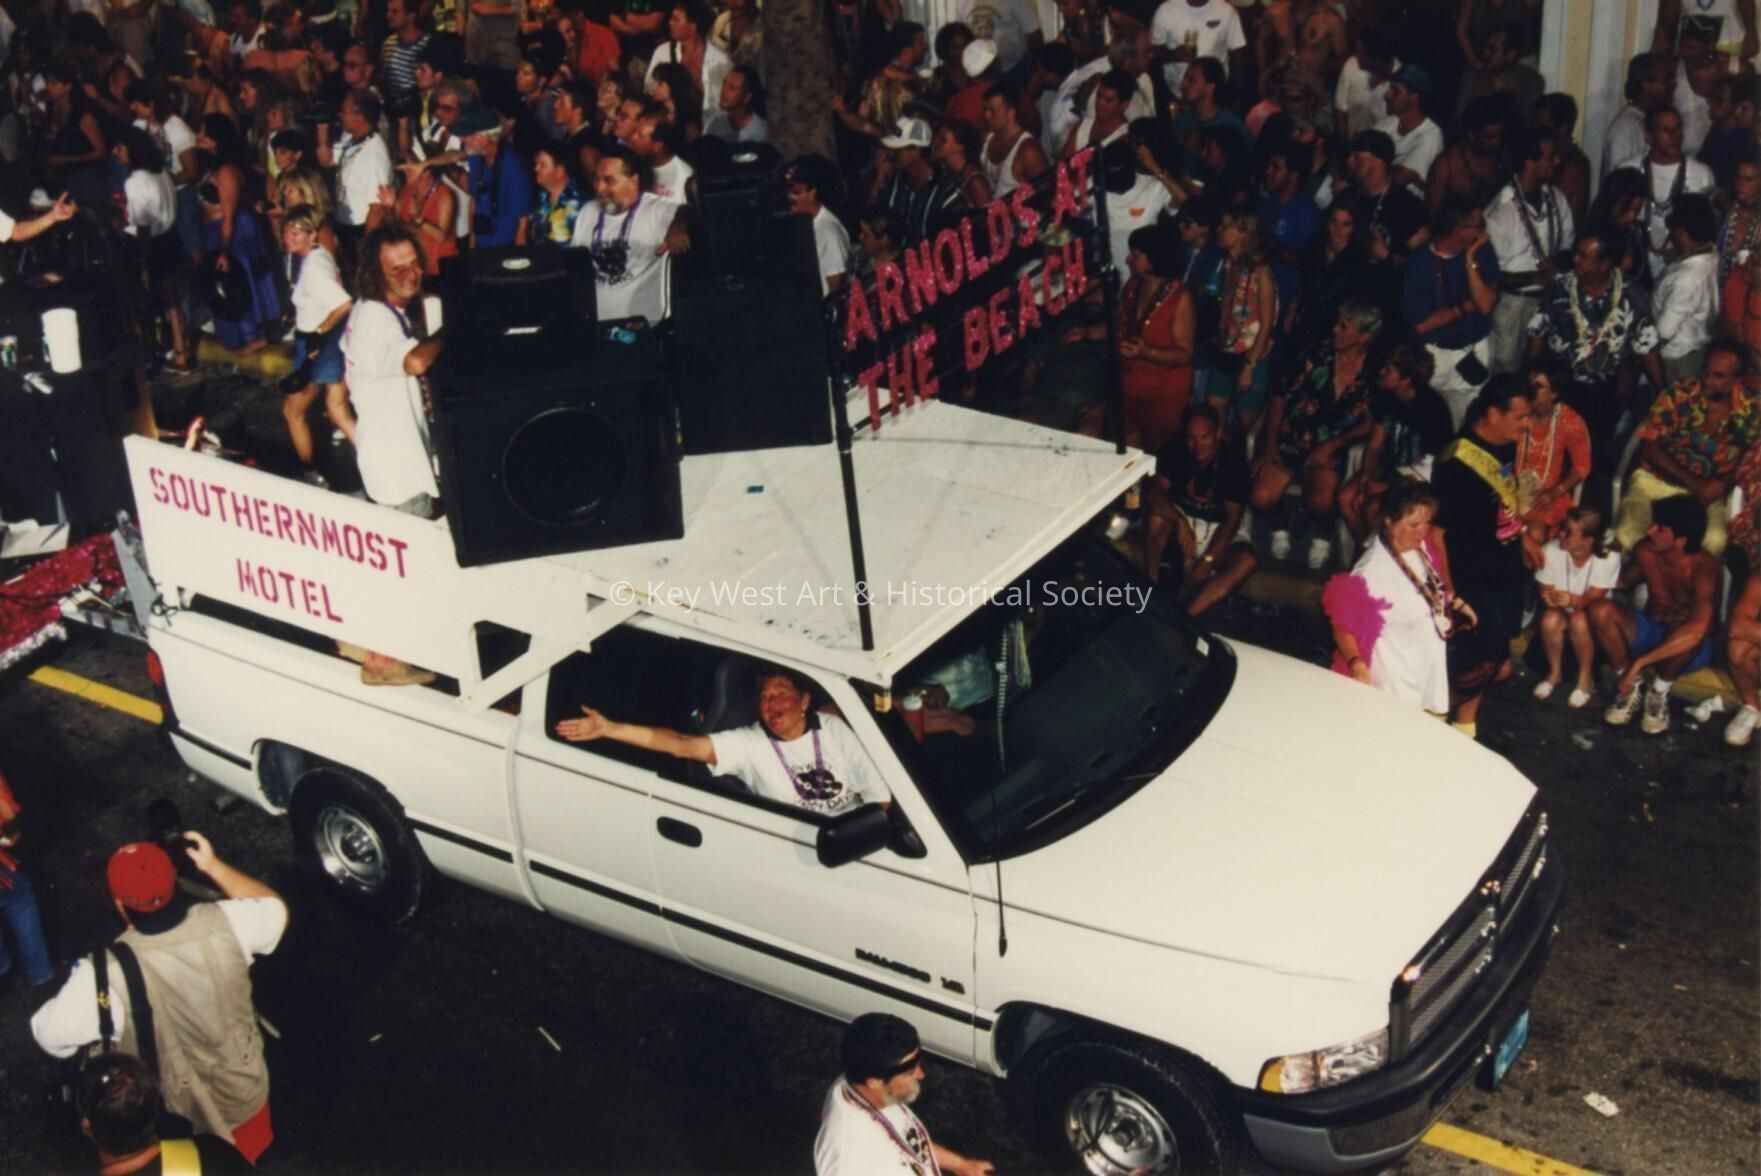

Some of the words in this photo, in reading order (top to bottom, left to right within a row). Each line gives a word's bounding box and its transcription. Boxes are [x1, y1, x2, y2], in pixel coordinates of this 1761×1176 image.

[845, 183, 1040, 352] ARNOLDS
[1053, 147, 1095, 228] AT
[858, 329, 940, 432] THE
[963, 238, 1087, 372] BEACH
[149, 467, 408, 579] SOUTHERNMOST
[236, 557, 344, 624] MOTEL
